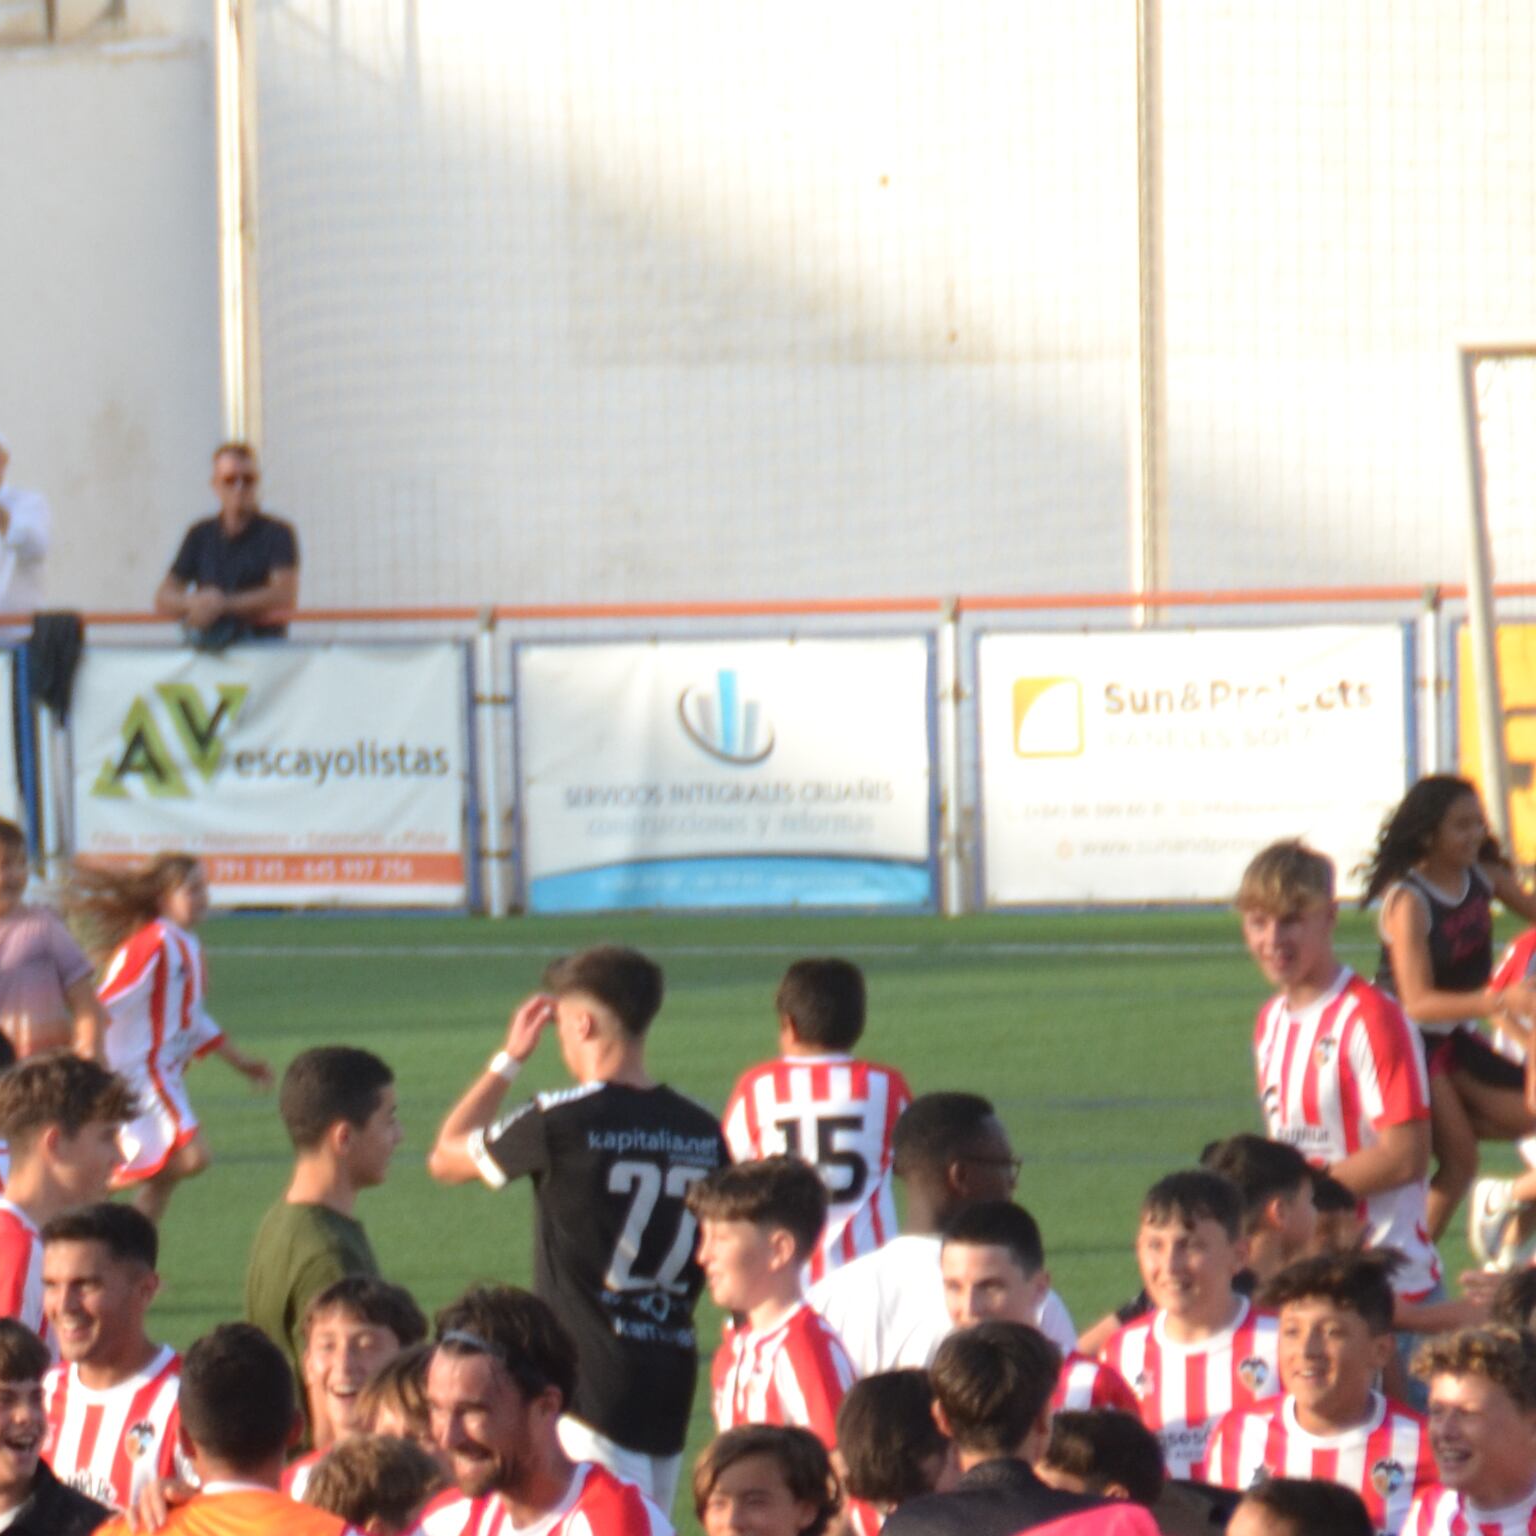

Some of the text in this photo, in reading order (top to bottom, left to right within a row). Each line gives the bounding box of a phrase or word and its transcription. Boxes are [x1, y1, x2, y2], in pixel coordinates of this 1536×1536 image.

[1104, 675, 1372, 718] Sun&Prcts
[91, 683, 249, 798] AV
[234, 740, 449, 787] escayolistas
[777, 1117, 868, 1203] 15
